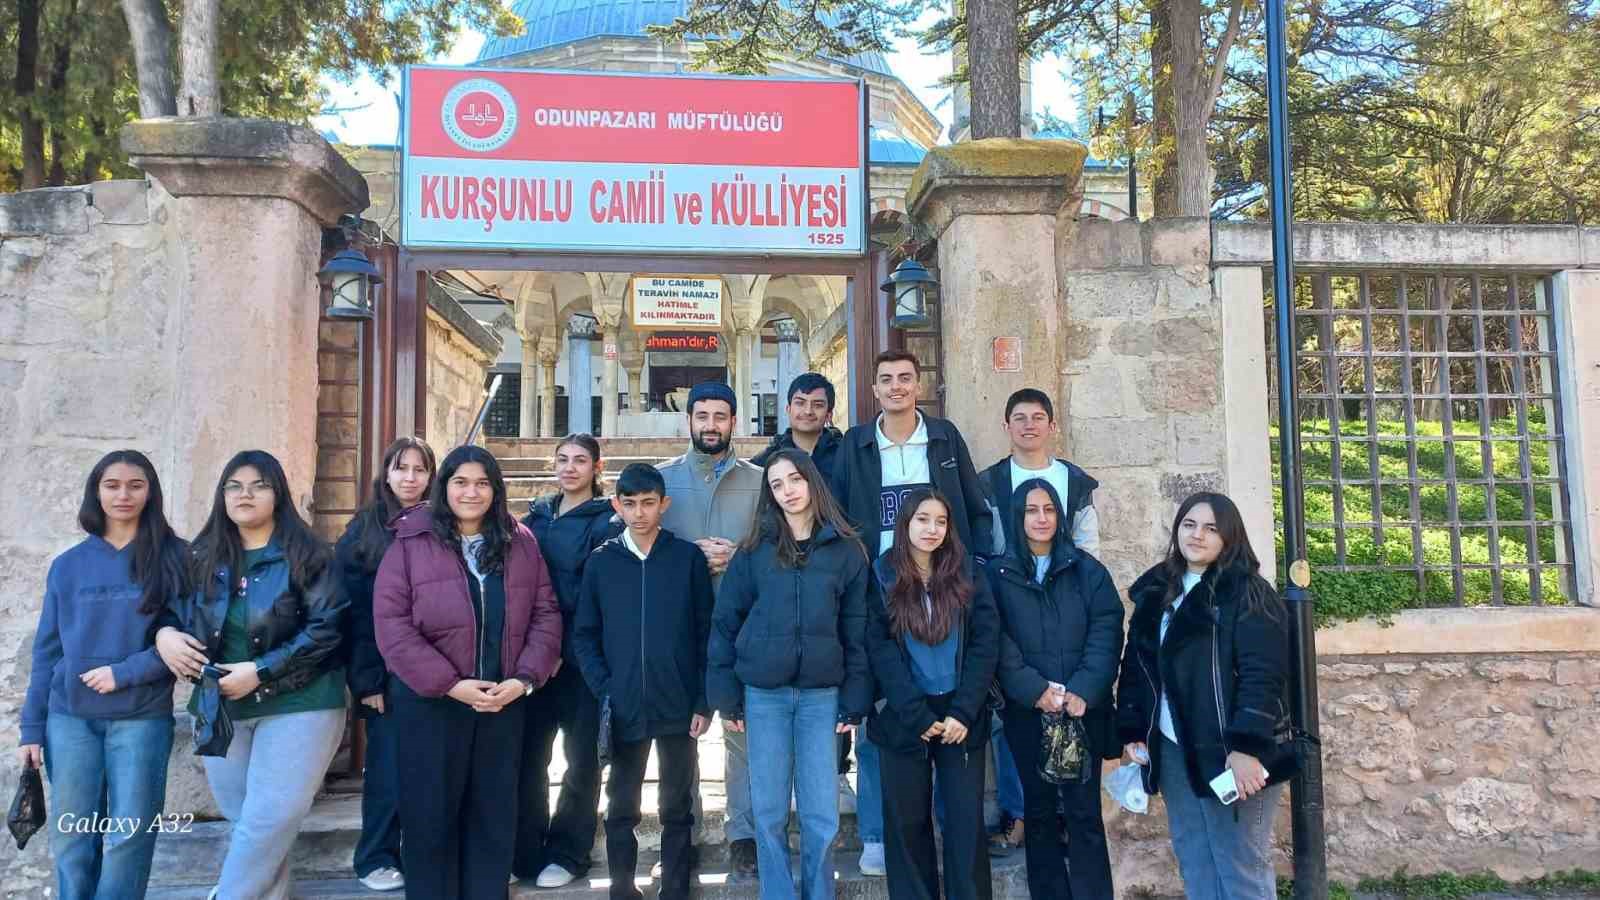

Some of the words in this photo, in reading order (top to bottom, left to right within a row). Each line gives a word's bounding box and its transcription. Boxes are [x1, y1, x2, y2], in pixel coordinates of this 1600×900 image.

[534, 108, 656, 129] ODUNPAZARI
[667, 110, 784, 132] MÜFTÜLÜĞÜ
[420, 174, 573, 232] KURŞUNLU
[590, 168, 665, 223] CAMİİ
[673, 192, 703, 225] ve
[711, 173, 848, 228] KÜLLİYESİ
[808, 232, 845, 244] 1525
[638, 289, 679, 297] TERAVİH
[682, 291, 719, 299] NAMAZI
[640, 311, 715, 320] KILINMAKTADIR
